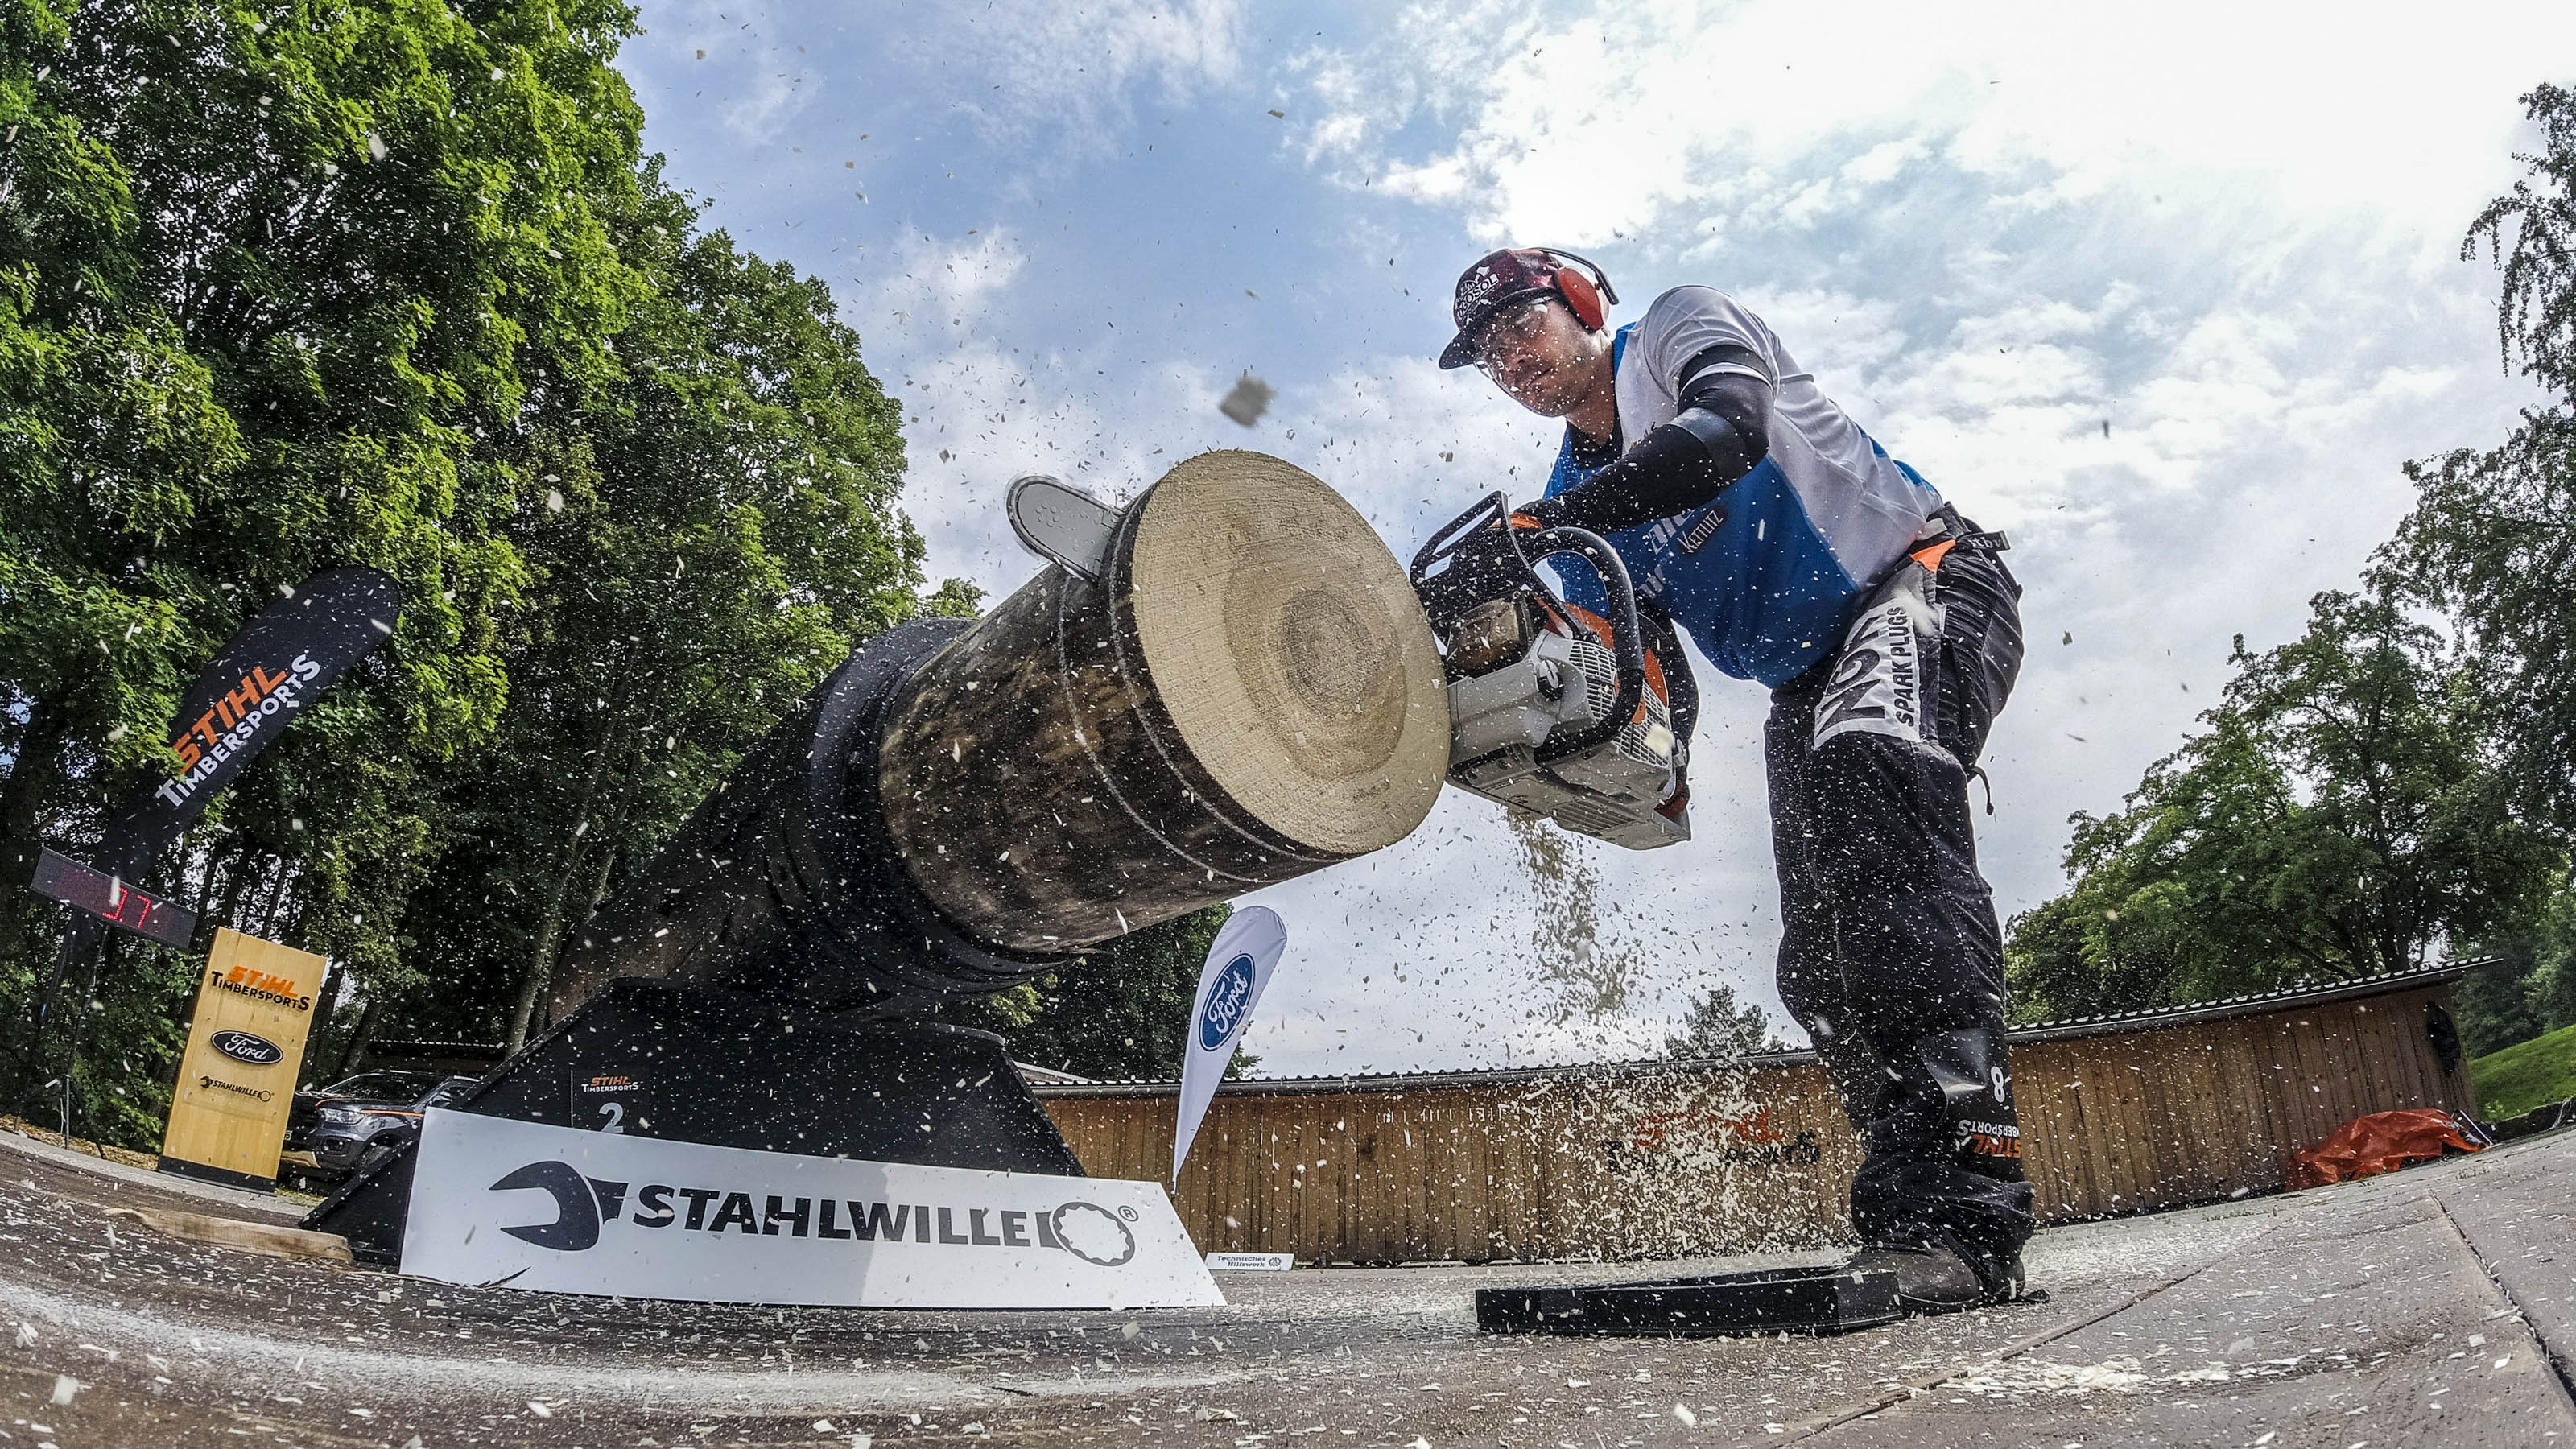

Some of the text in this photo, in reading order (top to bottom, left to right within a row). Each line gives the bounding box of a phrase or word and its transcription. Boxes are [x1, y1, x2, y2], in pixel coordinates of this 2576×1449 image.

[1456, 276, 1499, 321] OGOSOL
[1677, 510, 1724, 553] KETTLITZ
[1886, 607, 1916, 727] SPARK PLUGS
[172, 665, 287, 774] STIHL
[227, 966, 299, 997] STIHL
[1208, 970, 1249, 1034] Ford
[225, 1034, 270, 1060] Ford
[212, 1080, 259, 1098] STAHLWILLE
[591, 1075, 631, 1086] STIHL
[1990, 1066, 2005, 1103] 8
[598, 1102, 624, 1133] 2
[1971, 1133, 2021, 1158] STIHL
[632, 1184, 1031, 1248] STAHLWILLE
